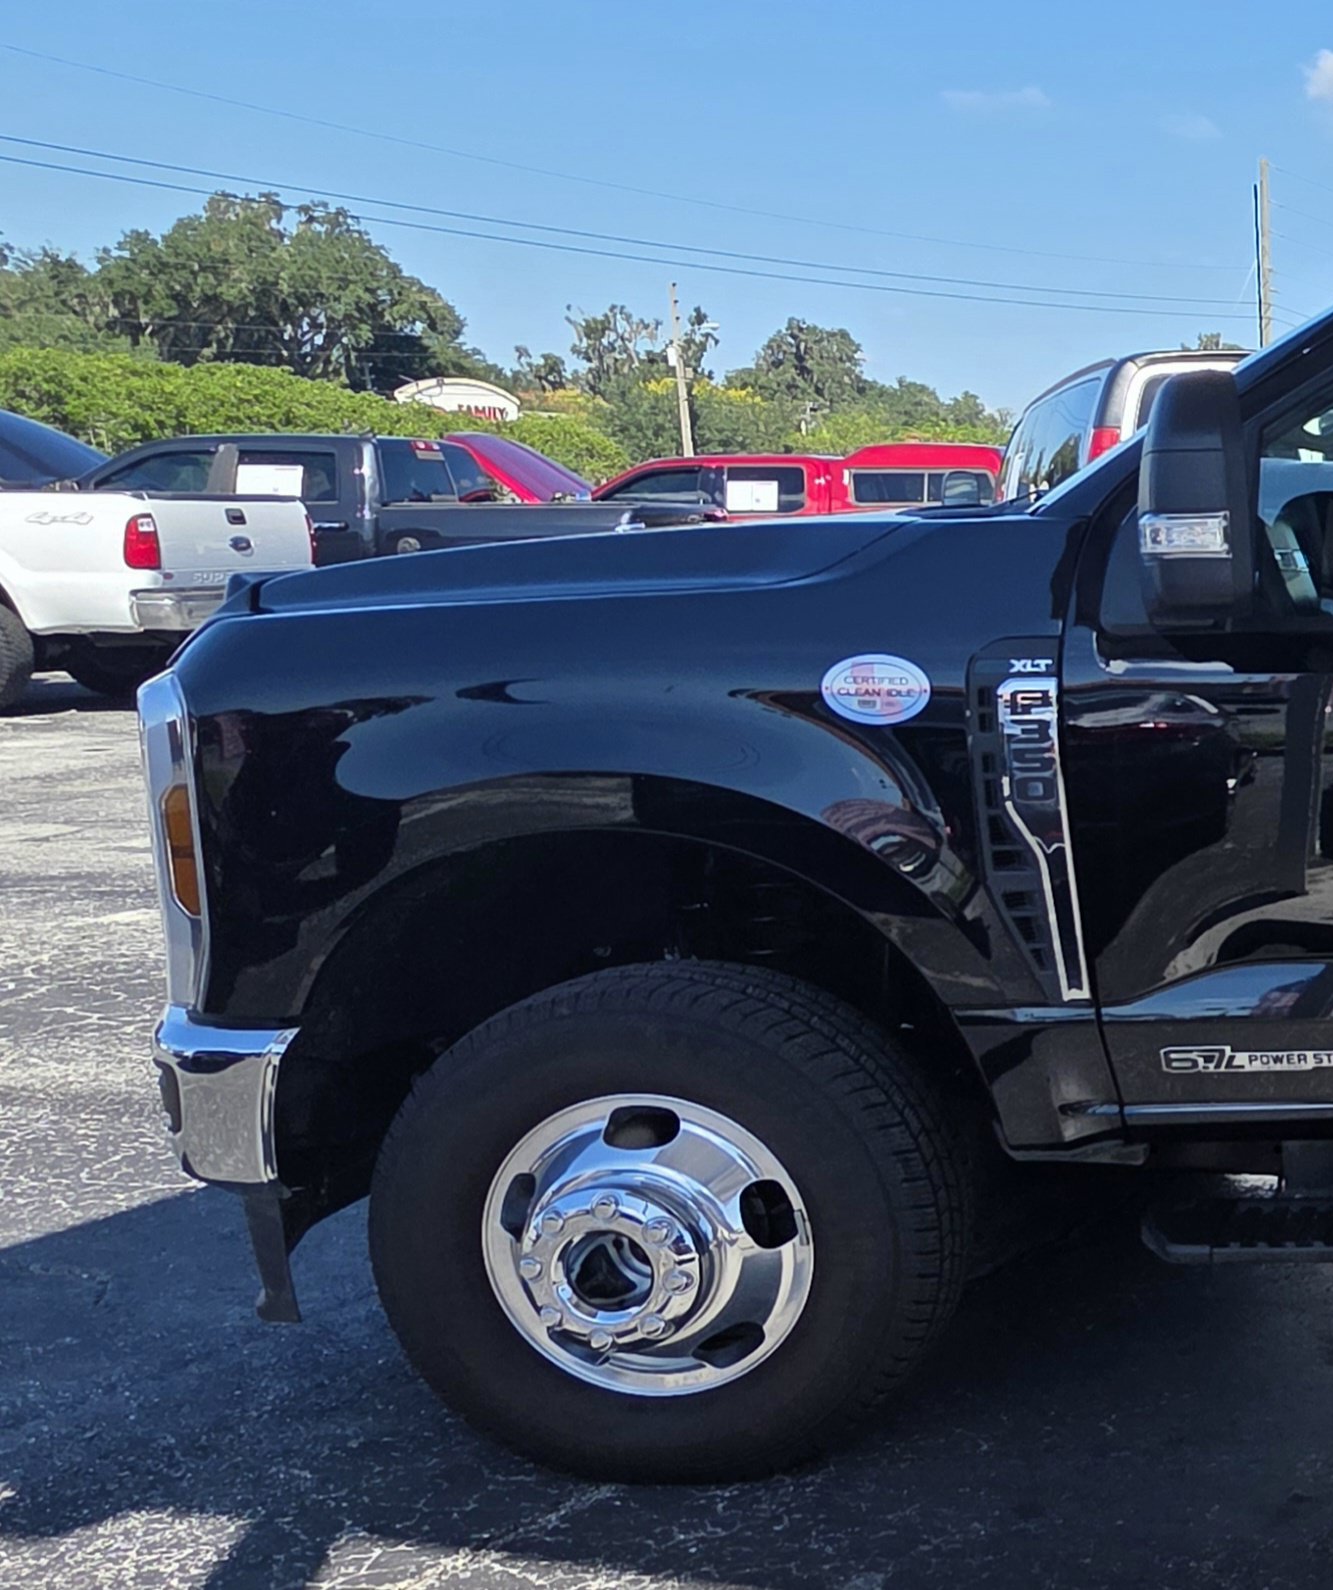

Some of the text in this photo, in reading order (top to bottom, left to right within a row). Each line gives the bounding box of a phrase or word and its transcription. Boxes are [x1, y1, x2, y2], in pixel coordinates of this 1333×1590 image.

[1008, 658, 1053, 673] XLT
[844, 676, 909, 686] CERTIFIED
[838, 687, 915, 698] CLEAN IDLE
[1250, 1053, 1308, 1066] POWER
